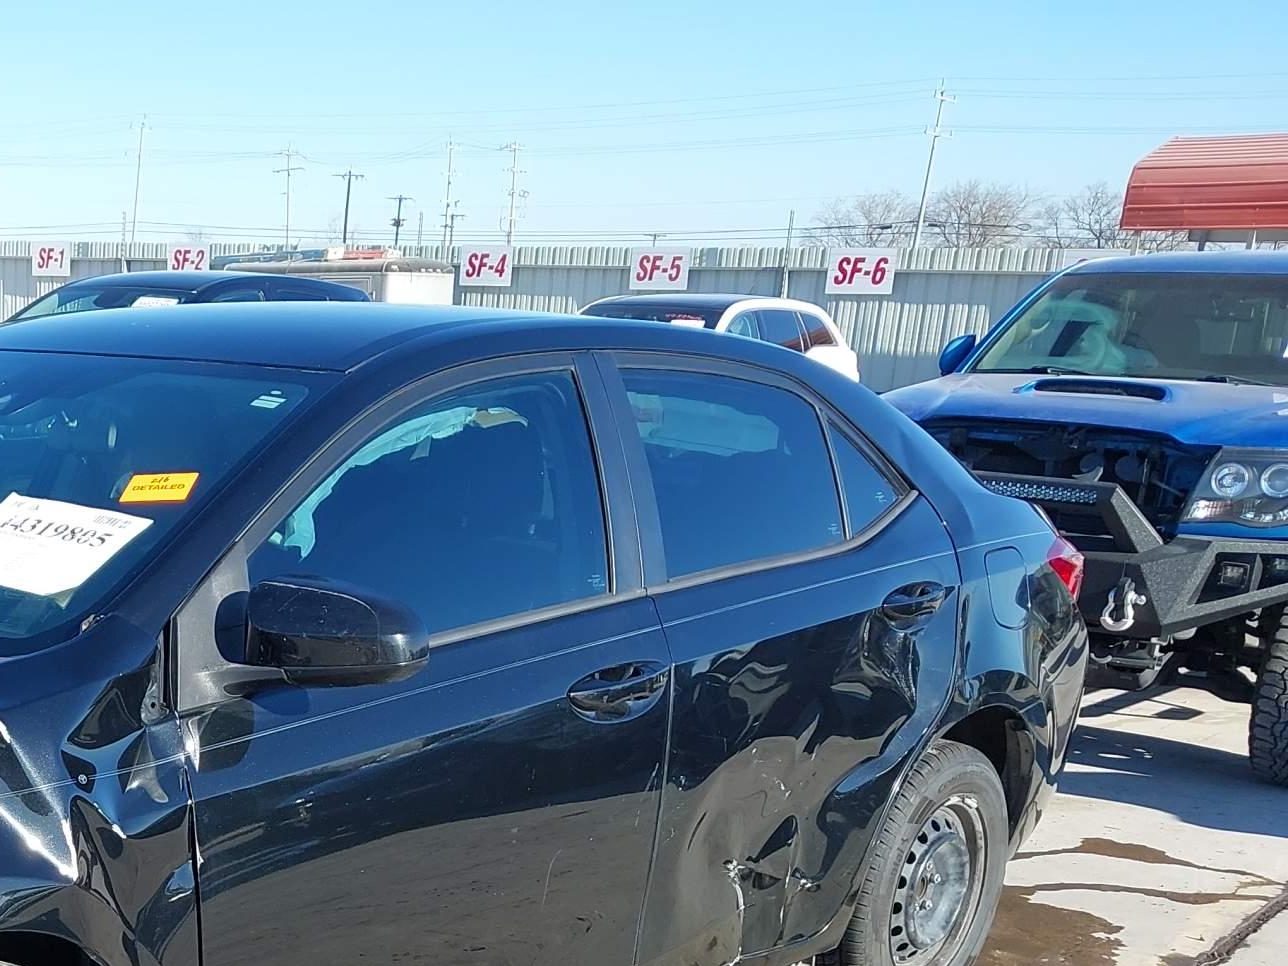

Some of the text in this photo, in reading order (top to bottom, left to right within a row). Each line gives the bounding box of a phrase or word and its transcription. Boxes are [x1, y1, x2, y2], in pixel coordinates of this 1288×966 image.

[37, 247, 65, 269] SF-1
[171, 249, 205, 271] SF-2
[464, 252, 508, 278] SF-4
[635, 254, 683, 282] SF-5
[833, 256, 889, 286] SF-6
[131, 483, 186, 492] DETAILED
